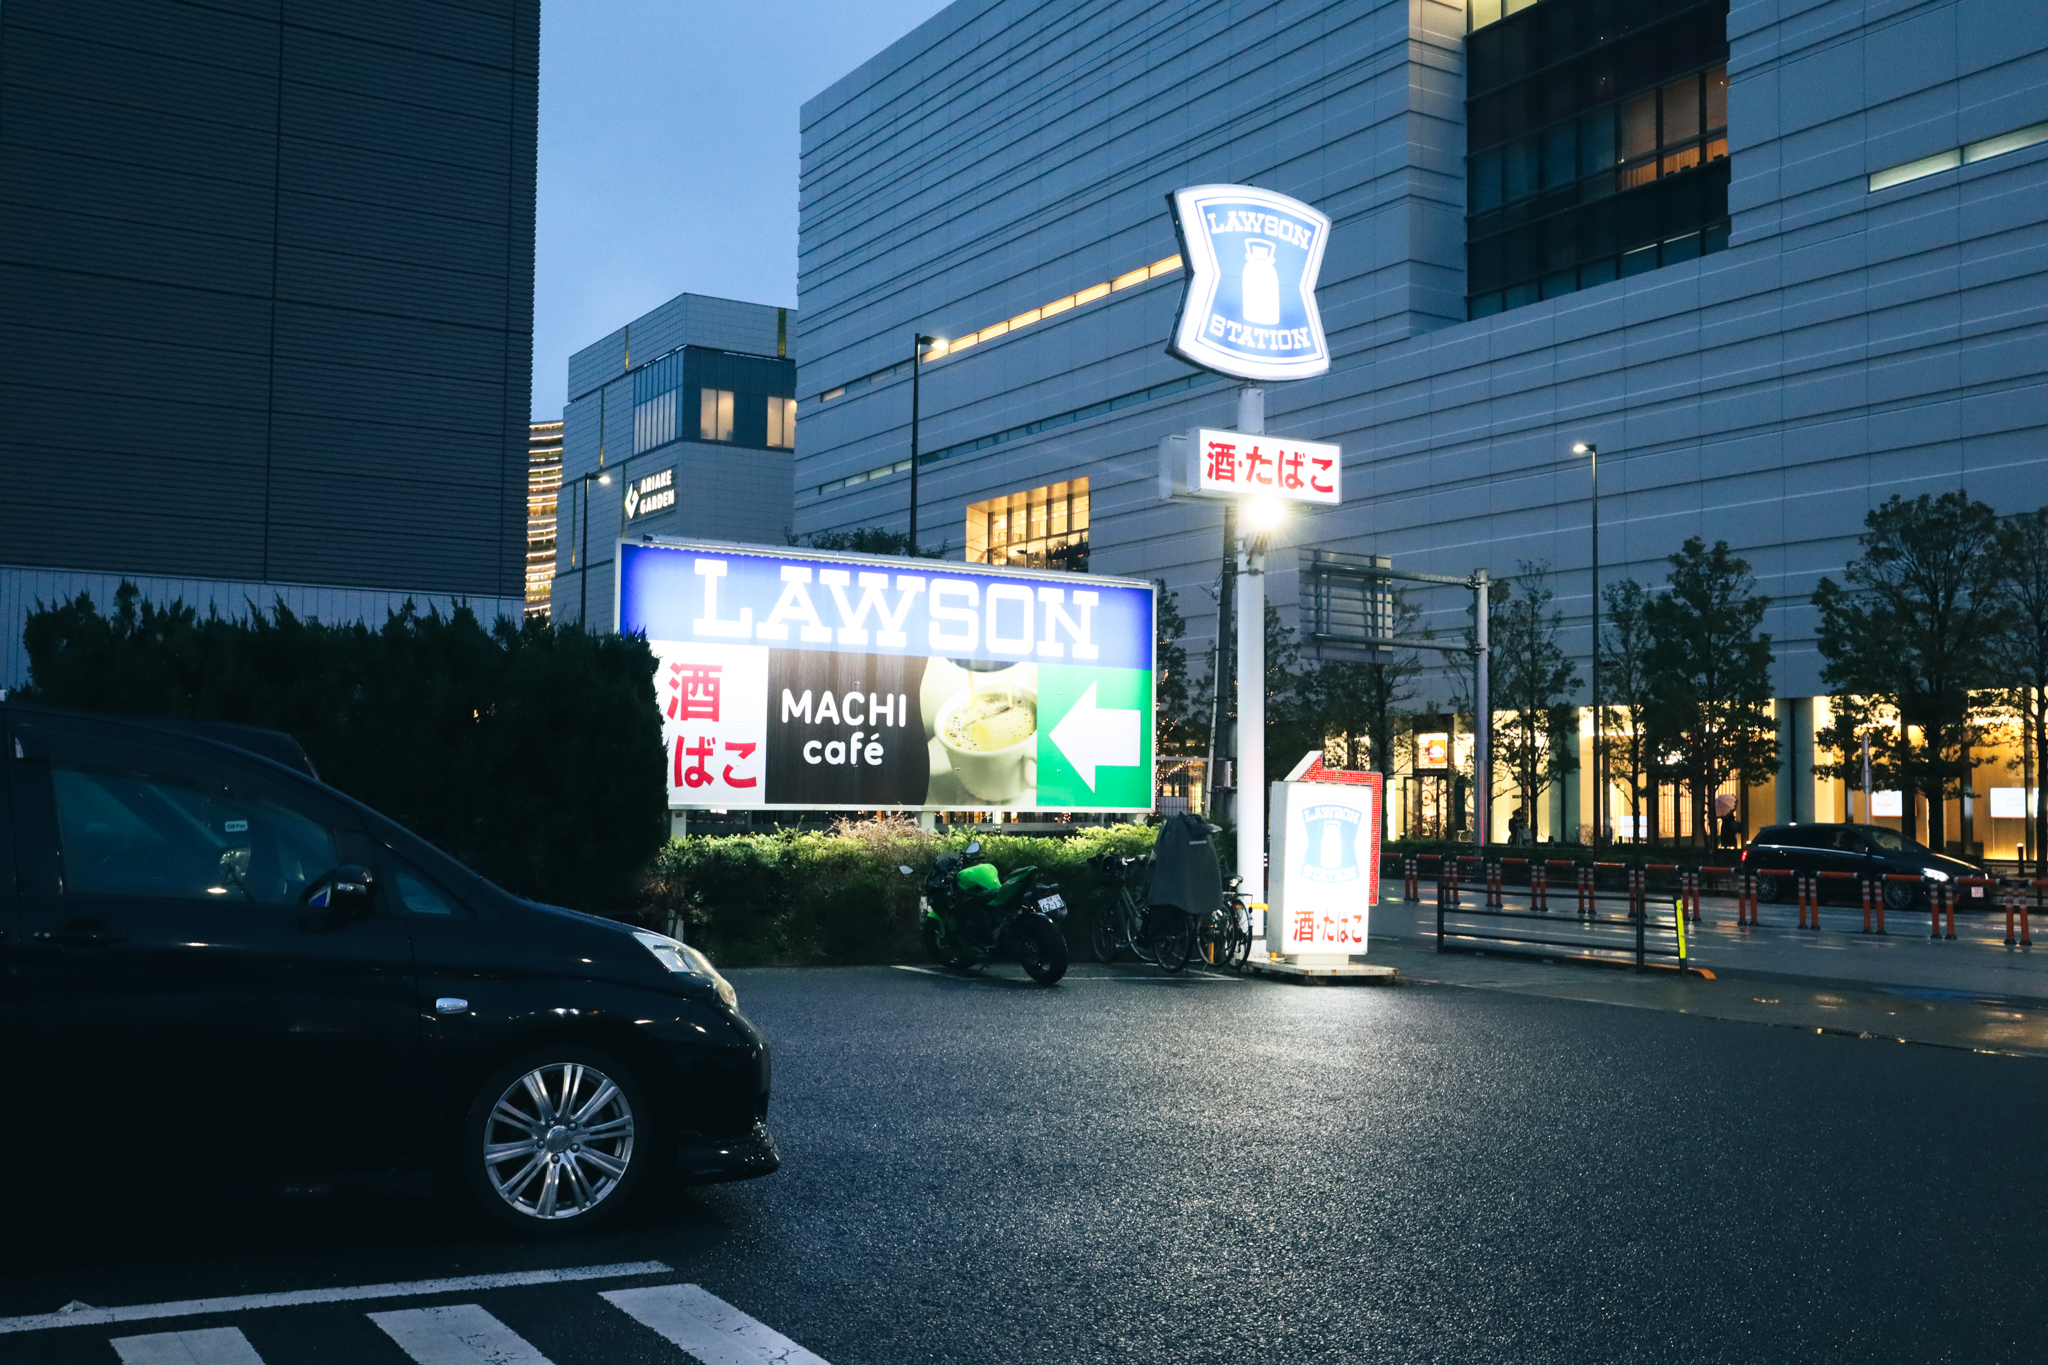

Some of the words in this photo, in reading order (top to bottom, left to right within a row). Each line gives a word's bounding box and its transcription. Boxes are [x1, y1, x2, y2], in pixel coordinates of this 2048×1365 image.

[1207, 211, 1312, 250] LAWSON
[1209, 314, 1311, 350] STATION
[641, 469, 672, 494] ARIAKE
[1207, 440, 1334, 493] 酒・たばこ
[640, 489, 675, 514] GARDEN
[693, 558, 1099, 660] LAWSON
[666, 662, 723, 722] 酒
[781, 688, 907, 727] MACHI
[803, 731, 884, 766] café
[1303, 806, 1361, 825] LAWSON
[1302, 864, 1358, 882] STATION
